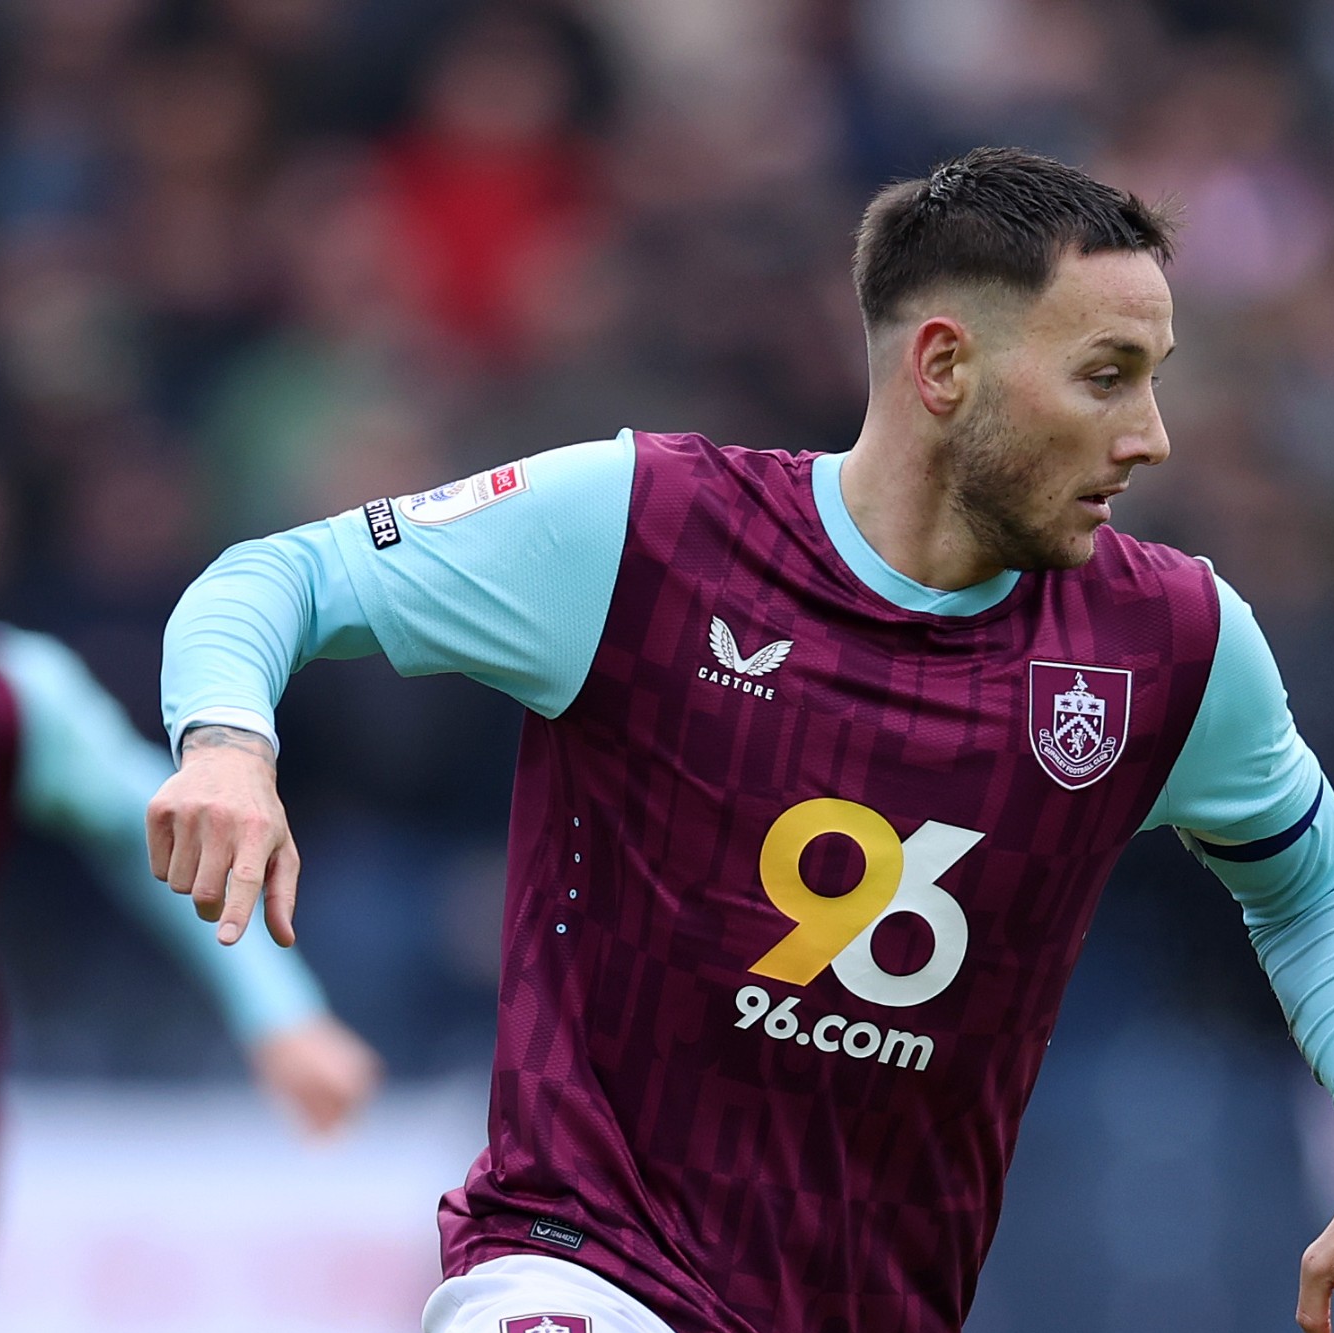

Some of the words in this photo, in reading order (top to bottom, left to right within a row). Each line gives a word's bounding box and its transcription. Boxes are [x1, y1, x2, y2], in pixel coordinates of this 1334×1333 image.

[698, 667, 775, 701] CASTORE
[1043, 746, 1067, 769] BURNLEY
[1065, 763, 1095, 775] FOOTBALL
[1092, 752, 1109, 766] CLUB
[747, 797, 986, 1007] 96
[733, 985, 934, 1071] 96.com
